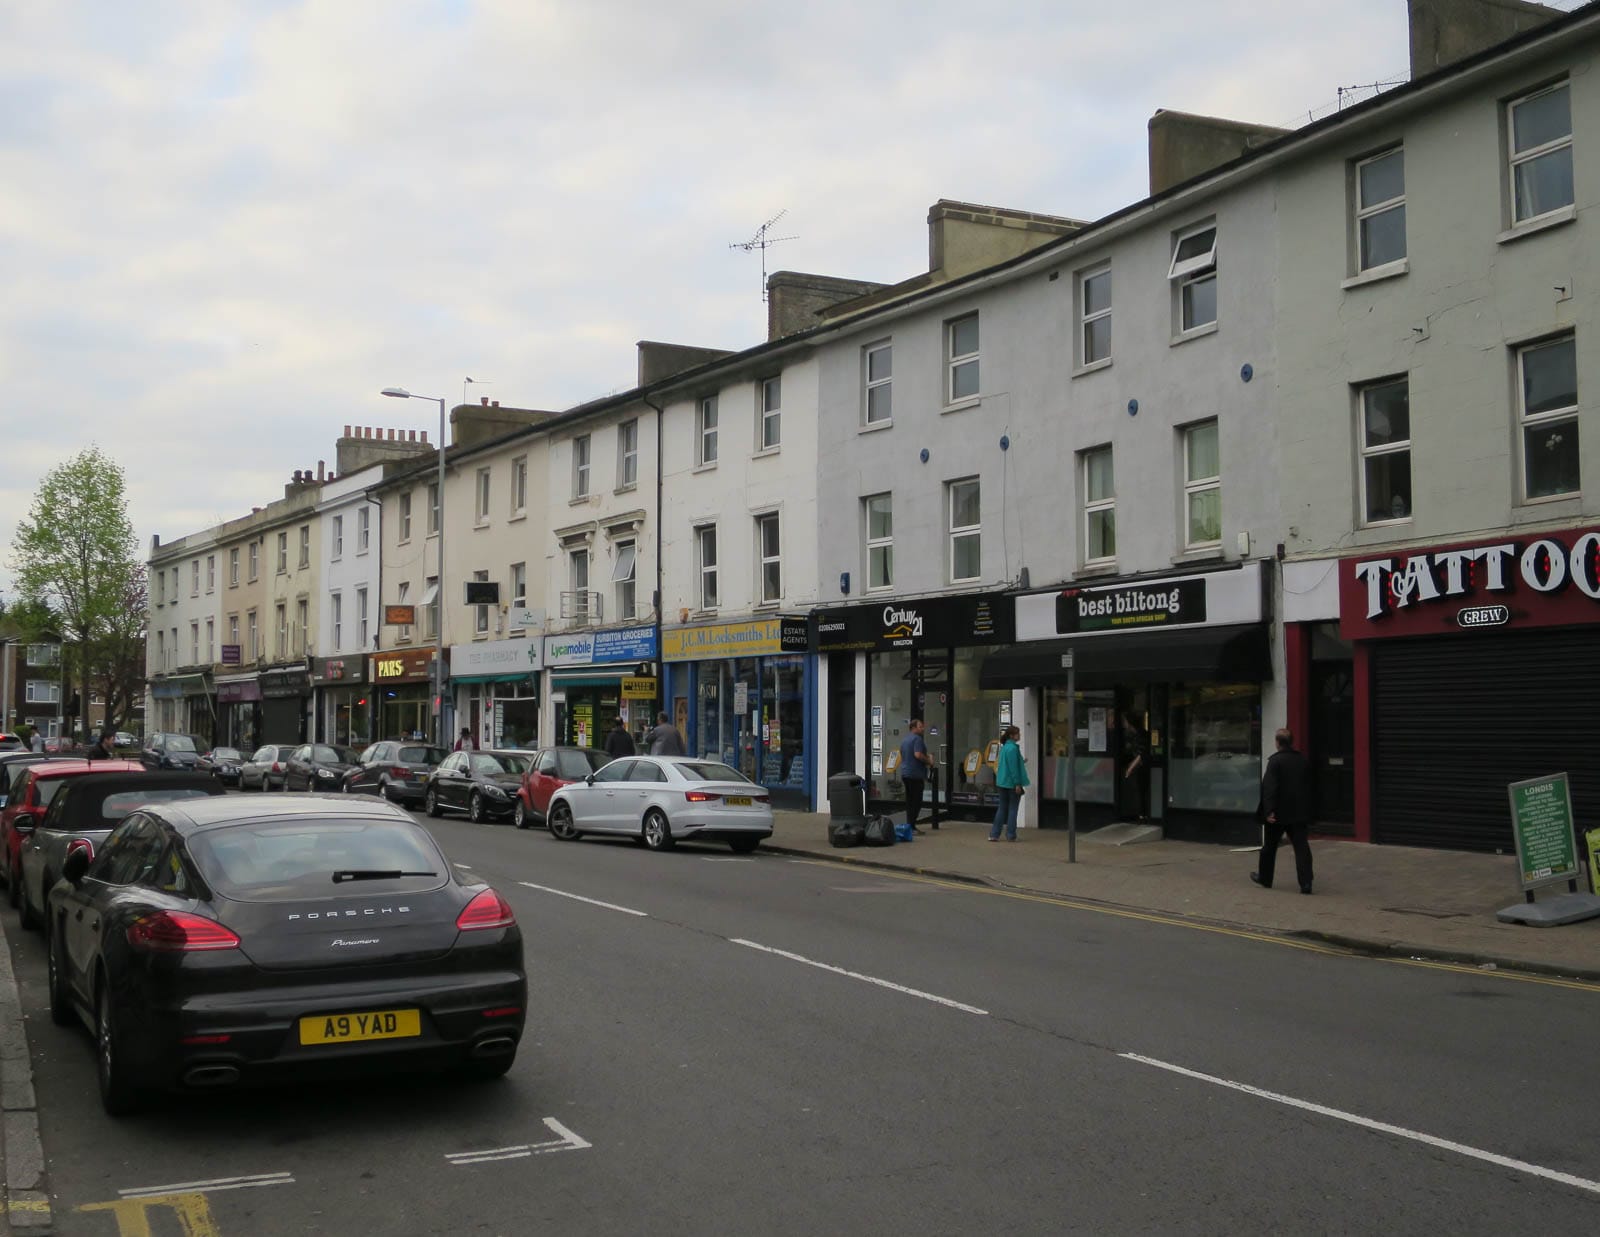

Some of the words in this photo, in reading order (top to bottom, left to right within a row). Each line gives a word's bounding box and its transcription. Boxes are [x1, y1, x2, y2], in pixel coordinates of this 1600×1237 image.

[1356, 532, 1600, 619] TATTOO
[1078, 595, 1112, 616] best
[1116, 589, 1180, 613] biltong
[882, 606, 917, 627] Century
[1464, 609, 1502, 623] CREW
[623, 628, 654, 640] GROCERIES
[783, 627, 806, 635] ESTATE
[912, 617, 923, 637] 21
[782, 635, 808, 645] AGENTS
[551, 641, 591, 658] Lycamobile
[378, 660, 405, 678] PARS
[1524, 783, 1554, 796] LONDIS
[288, 906, 411, 921] PORSCHE
[331, 938, 380, 947] Panamera
[325, 1017, 351, 1039] A9
[357, 1013, 397, 1036] YAD
